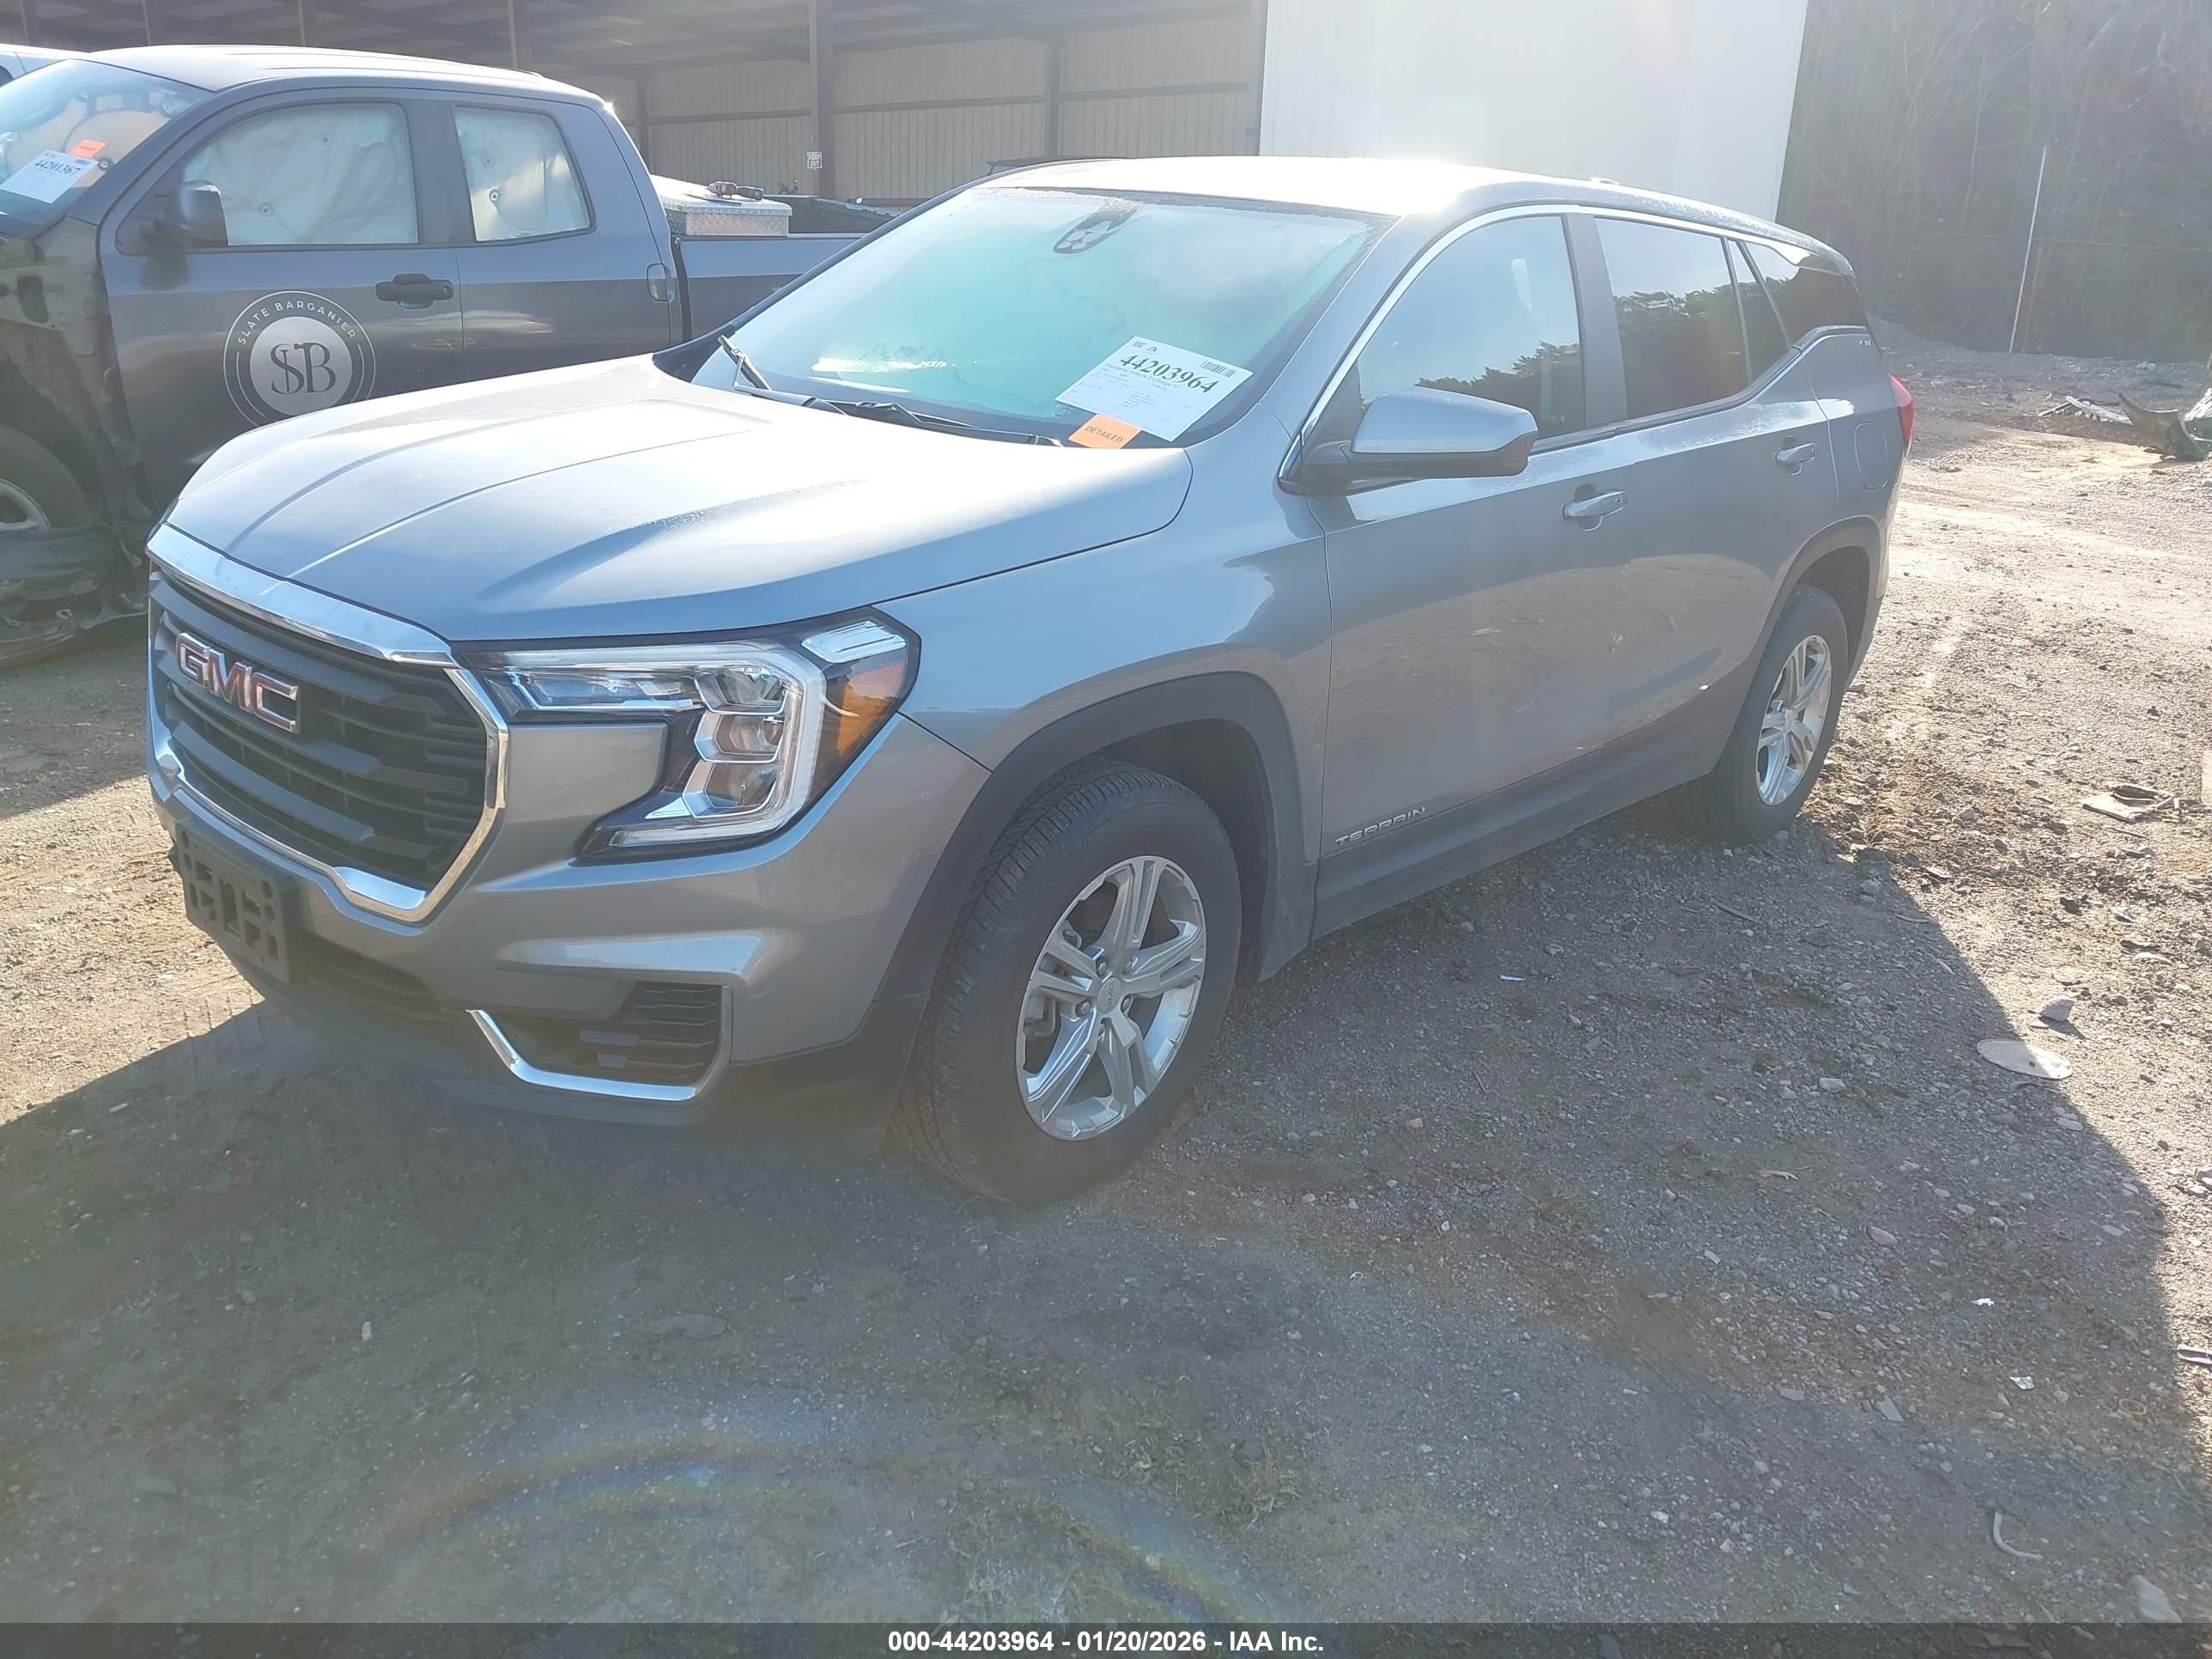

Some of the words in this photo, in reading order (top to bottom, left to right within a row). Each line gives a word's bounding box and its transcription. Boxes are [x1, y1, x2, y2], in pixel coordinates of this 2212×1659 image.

[238, 307, 270, 344] SLATE
[275, 301, 356, 339] BARGANIER
[1120, 355, 1219, 392] 44203964
[1085, 426, 1124, 443] DETAILED
[175, 632, 299, 733] GMC
[1334, 806, 1426, 846] TERRAIN
